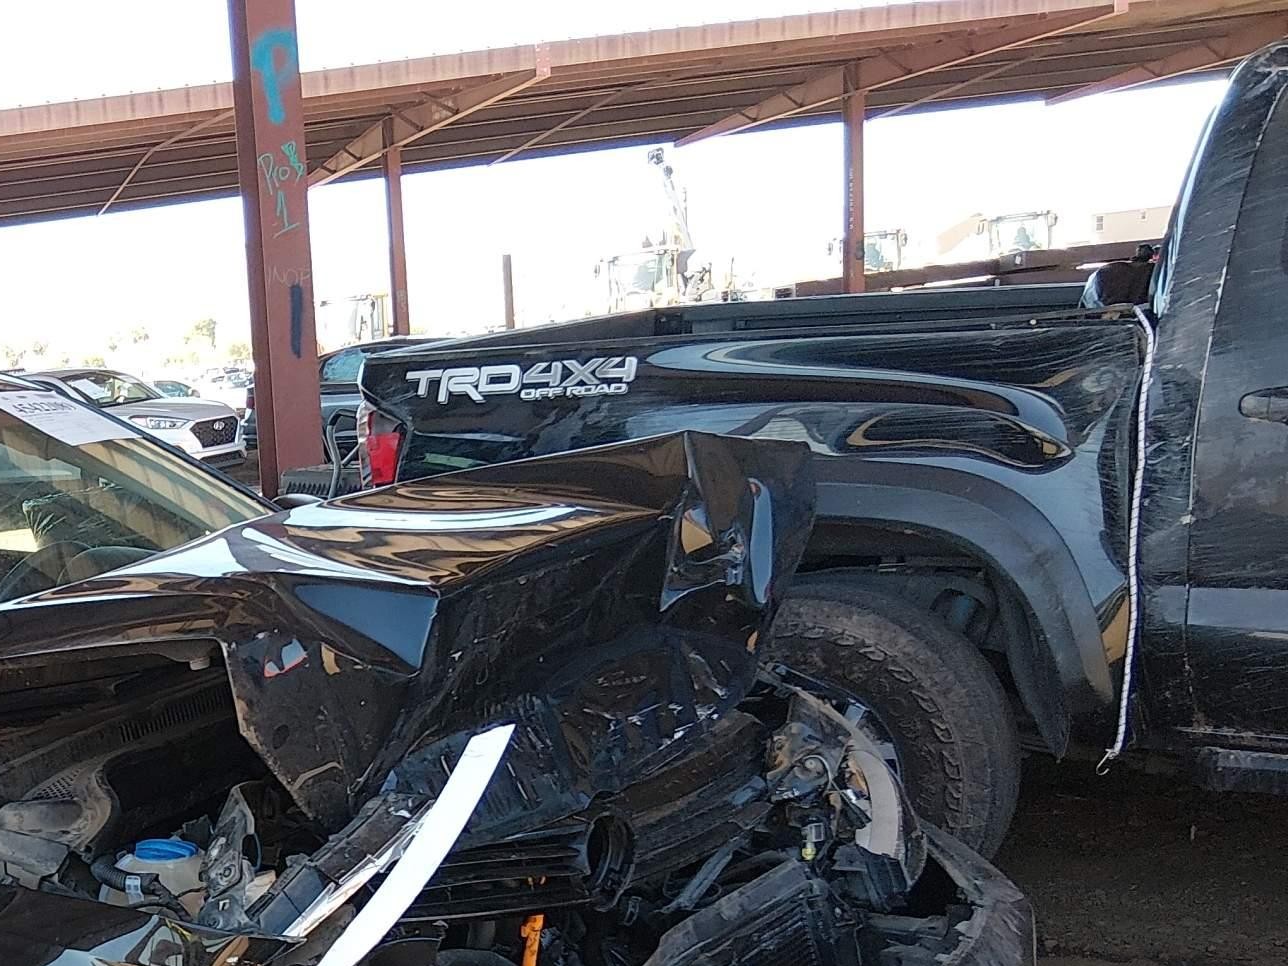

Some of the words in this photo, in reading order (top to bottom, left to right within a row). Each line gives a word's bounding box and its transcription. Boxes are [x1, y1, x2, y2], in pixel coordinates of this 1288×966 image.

[405, 364, 522, 404] TRD
[520, 386, 562, 401] OFF
[566, 382, 629, 398] ROAD
